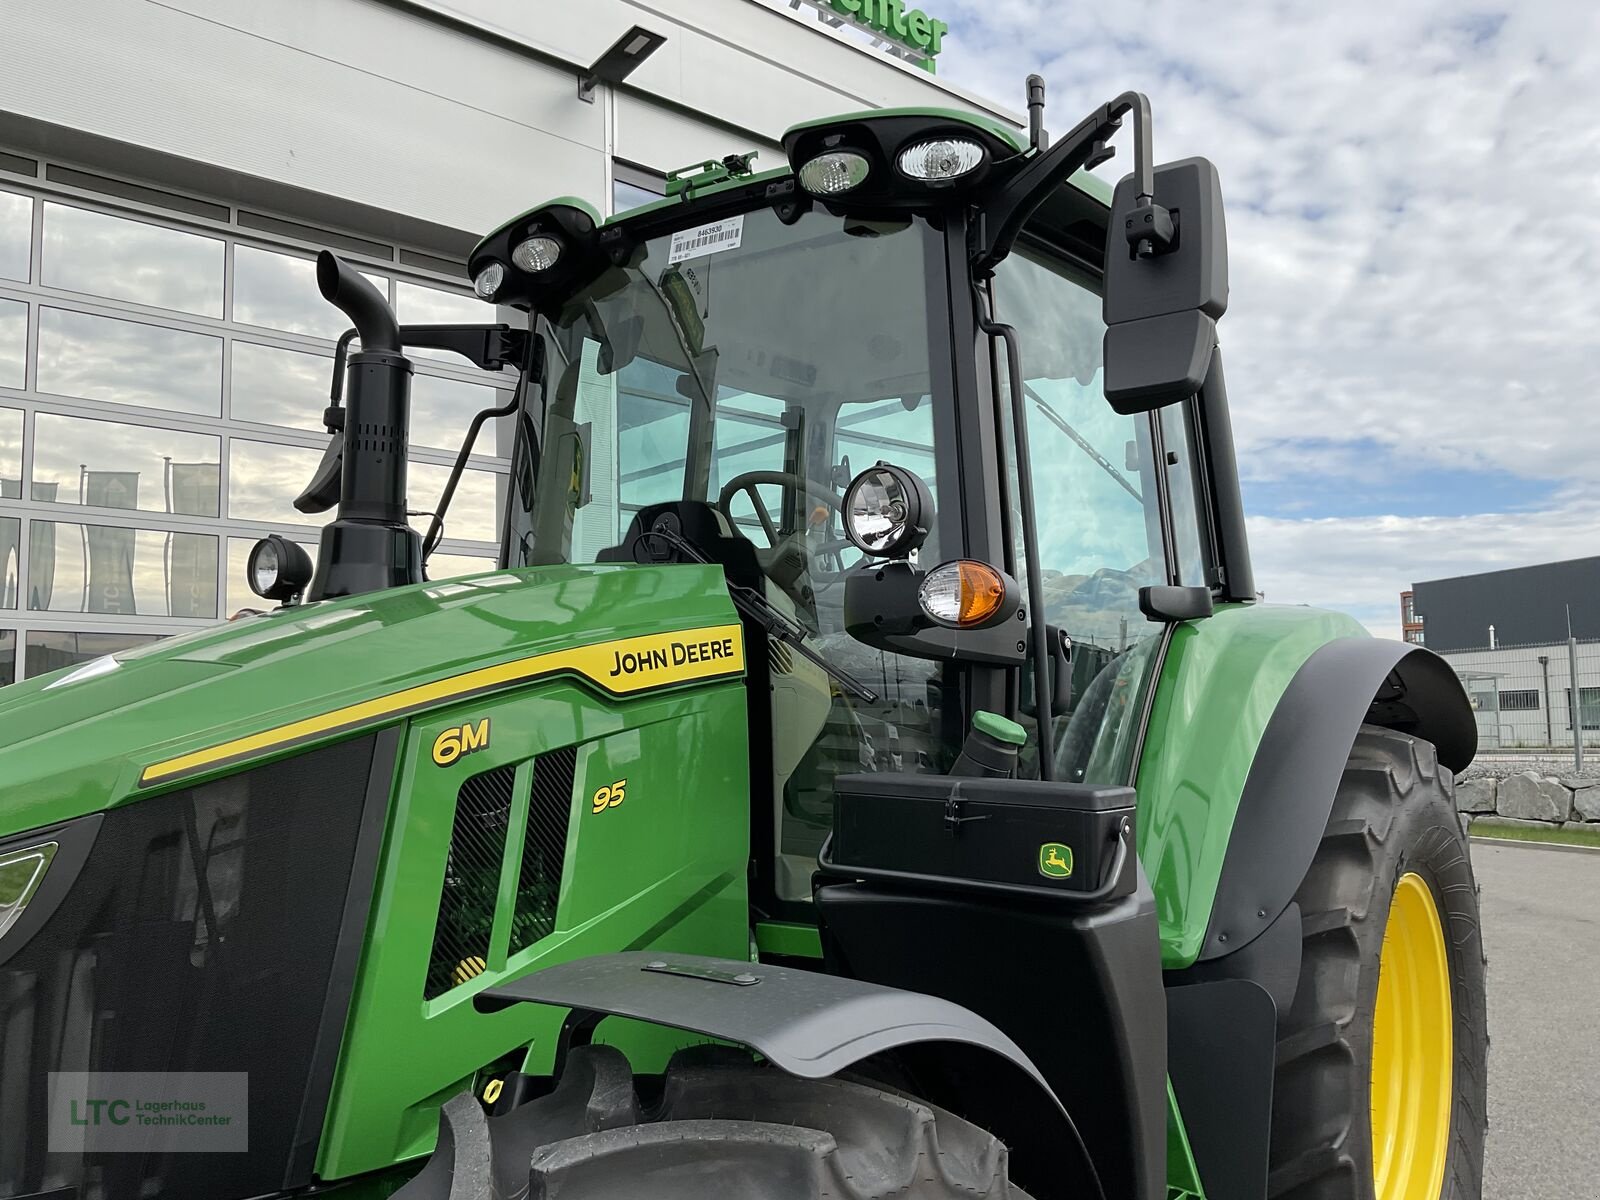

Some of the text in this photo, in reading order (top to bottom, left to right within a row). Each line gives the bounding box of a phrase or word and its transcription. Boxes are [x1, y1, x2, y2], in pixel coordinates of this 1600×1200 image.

[610, 639, 733, 676] JOHN DEERE
[432, 717, 490, 767] 6M
[592, 779, 627, 814] 95
